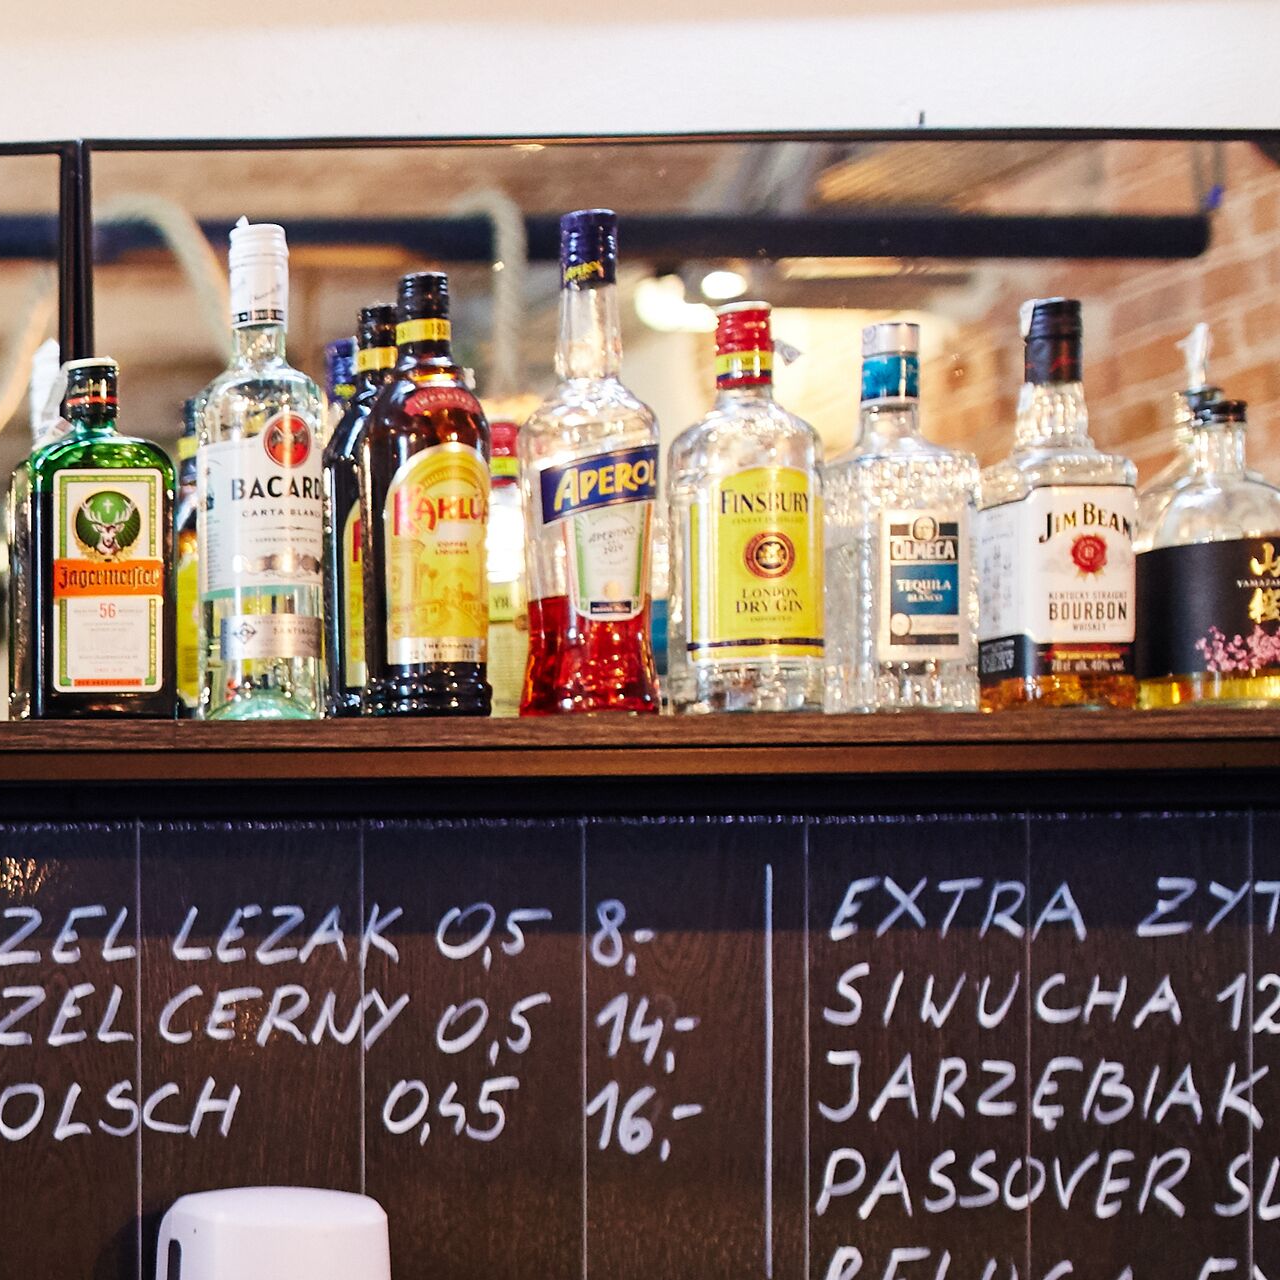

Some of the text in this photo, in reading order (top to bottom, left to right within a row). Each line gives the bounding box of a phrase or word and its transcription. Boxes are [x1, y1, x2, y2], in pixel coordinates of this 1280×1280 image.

[553, 459, 657, 512] APEROL
[241, 507, 285, 518] CARTA
[720, 489, 809, 514] FINSBURY
[1038, 510, 1078, 544] JIM
[891, 539, 956, 561] OLMECA
[741, 587, 798, 599] LONDON
[895, 578, 952, 595] TEQUILA
[1048, 591, 1128, 600] KENTUCKY STRAIGHT
[99, 602, 117, 618] 56
[735, 598, 804, 613] DRY GIN
[1048, 601, 1128, 621] BOURBON
[829, 875, 1088, 943] EXTRA
[171, 904, 405, 968] LEZAK
[436, 902, 554, 972] 0,5
[157, 983, 411, 1053] CERNY
[436, 992, 552, 1068] 0,5
[817, 1050, 1270, 1132] JARZĘBIAK
[382, 1076, 520, 1147] 0,45
[815, 1147, 1192, 1221] PASSOVER
